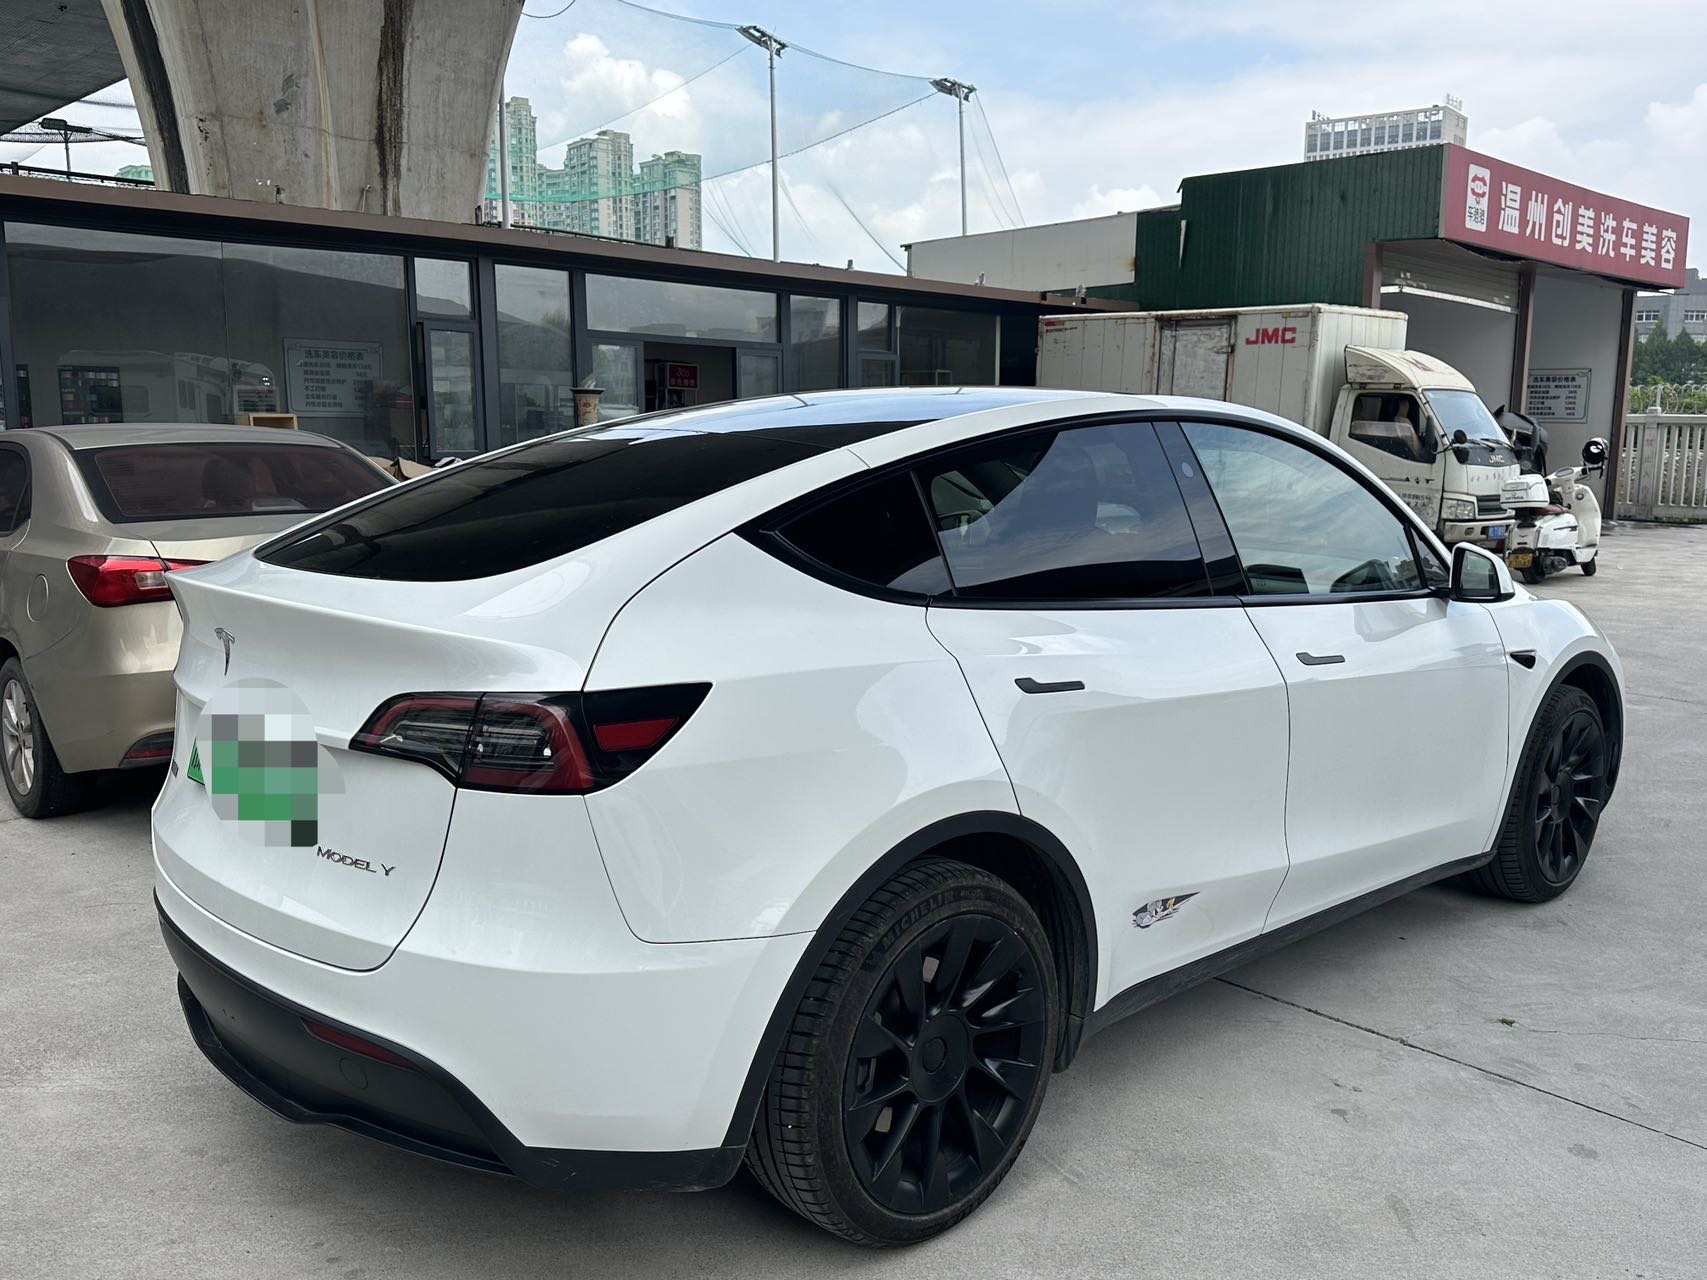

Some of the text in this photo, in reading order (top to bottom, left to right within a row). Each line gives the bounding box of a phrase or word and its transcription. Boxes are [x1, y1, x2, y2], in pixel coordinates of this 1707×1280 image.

[1498, 181, 1677, 270] 温州创美洗车美容
[1245, 327, 1297, 345] JMC
[1488, 454, 1505, 463] JMC
[317, 846, 397, 877] MODEL Y
